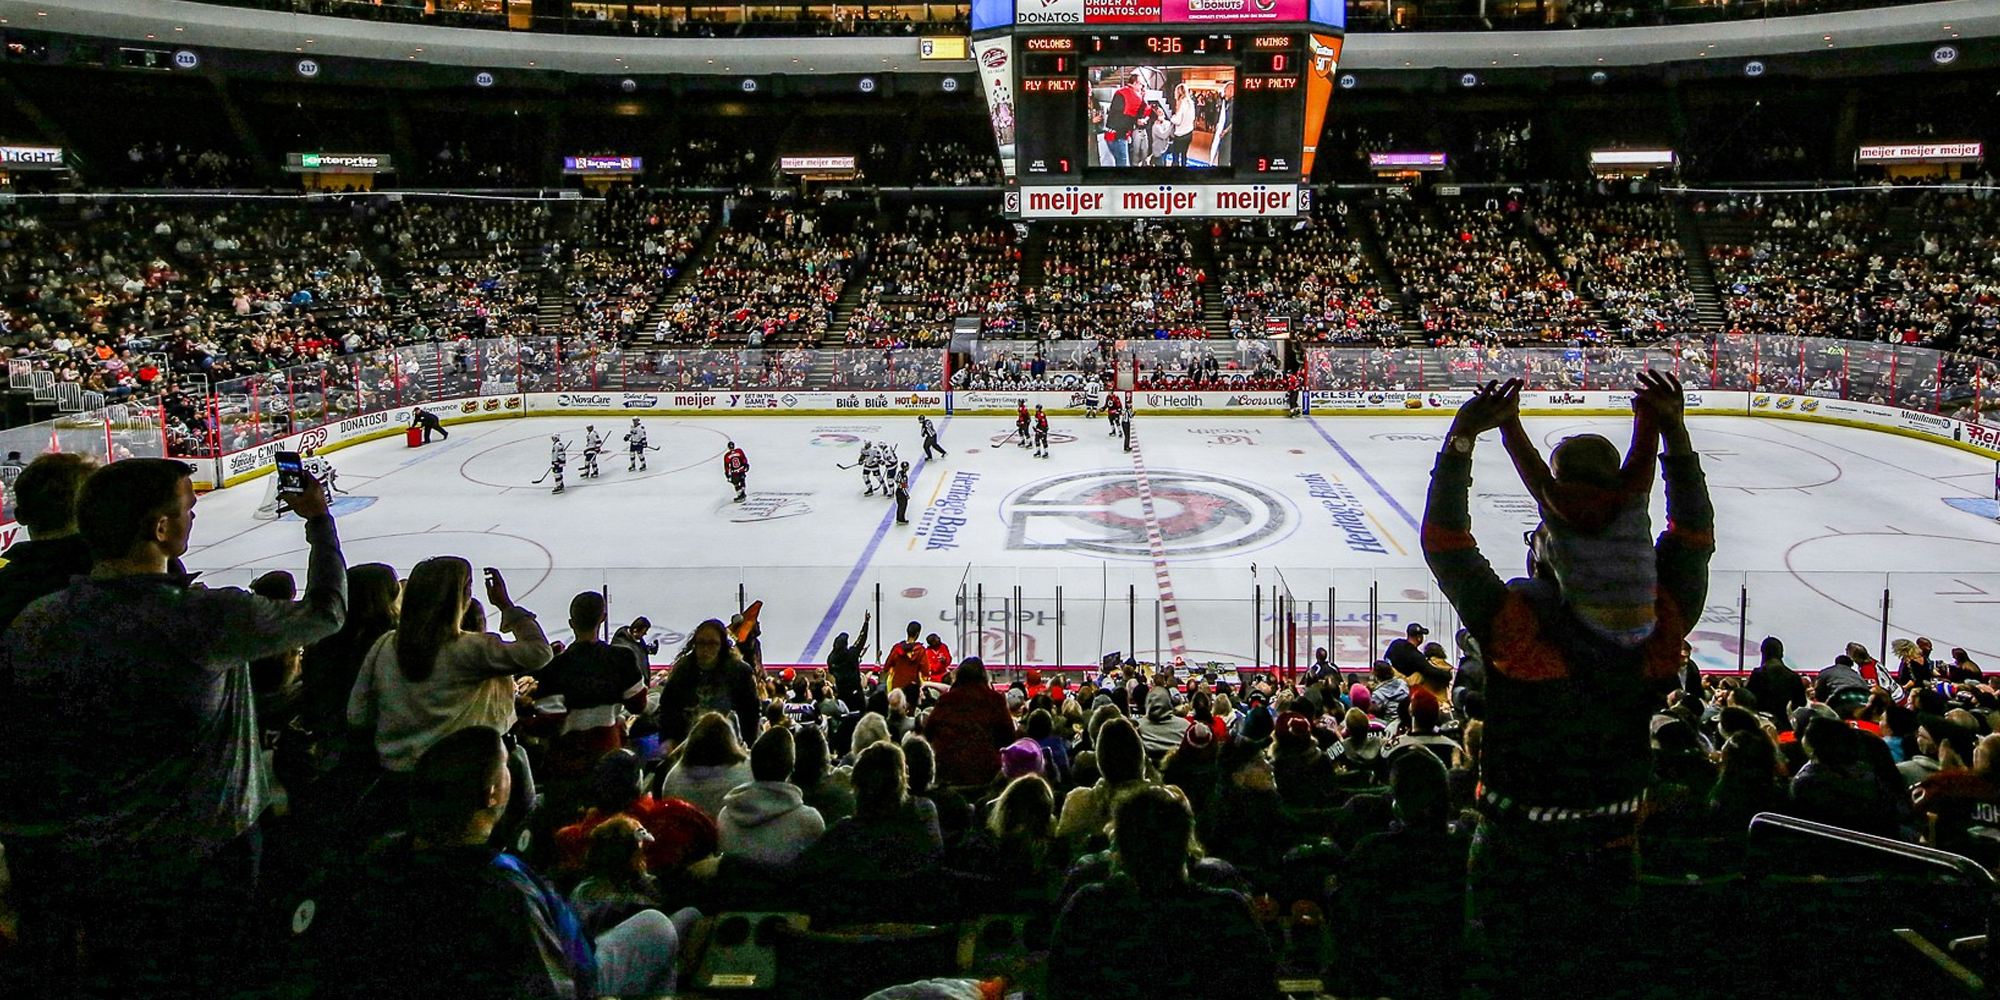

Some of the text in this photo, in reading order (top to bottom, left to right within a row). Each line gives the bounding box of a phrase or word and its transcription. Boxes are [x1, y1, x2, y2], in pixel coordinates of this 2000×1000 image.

[1204, 1, 1241, 9] DONUTS
[1086, 7, 1160, 16] DONATOS.COM
[1018, 13, 1080, 23] DONATOS
[1028, 39, 1071, 49] CYCLONES
[1148, 37, 1181, 53] 9:36
[1256, 37, 1288, 47] KWINGS
[178, 55, 194, 64] 218
[1937, 51, 1953, 59] 205
[301, 64, 315, 72] 217
[1057, 56, 1063, 72] 1
[1273, 55, 1285, 71] 0
[1025, 80, 1041, 91] PLY
[1245, 78, 1262, 89] PLY
[6, 151, 55, 162] LIGHT
[1861, 144, 1977, 158] meijer meijer meijer
[307, 156, 378, 166] enterprise
[782, 158, 854, 167] meijer meijer meijer
[1060, 160, 1068, 171] 7
[1258, 159, 1266, 171] 3
[1030, 185, 1291, 215] meijer meijer meijer
[571, 394, 611, 405] NovaCare
[675, 393, 717, 409] meijer
[895, 397, 940, 405] HOT HEAD
[1164, 394, 1203, 406] Health
[1238, 394, 1289, 405] Coors LIGH
[1385, 392, 1405, 401] Feeling
[423, 403, 458, 413] formance
[836, 397, 859, 408] Blue
[865, 397, 888, 408] Blue
[340, 415, 382, 433] DONATOS
[298, 427, 328, 454] ADP
[732, 457, 740, 468] 8
[1295, 471, 1341, 500] Bank
[926, 470, 981, 551] Heritage Bank
[1322, 499, 1389, 555] Heritage
[940, 609, 1066, 626] Health
